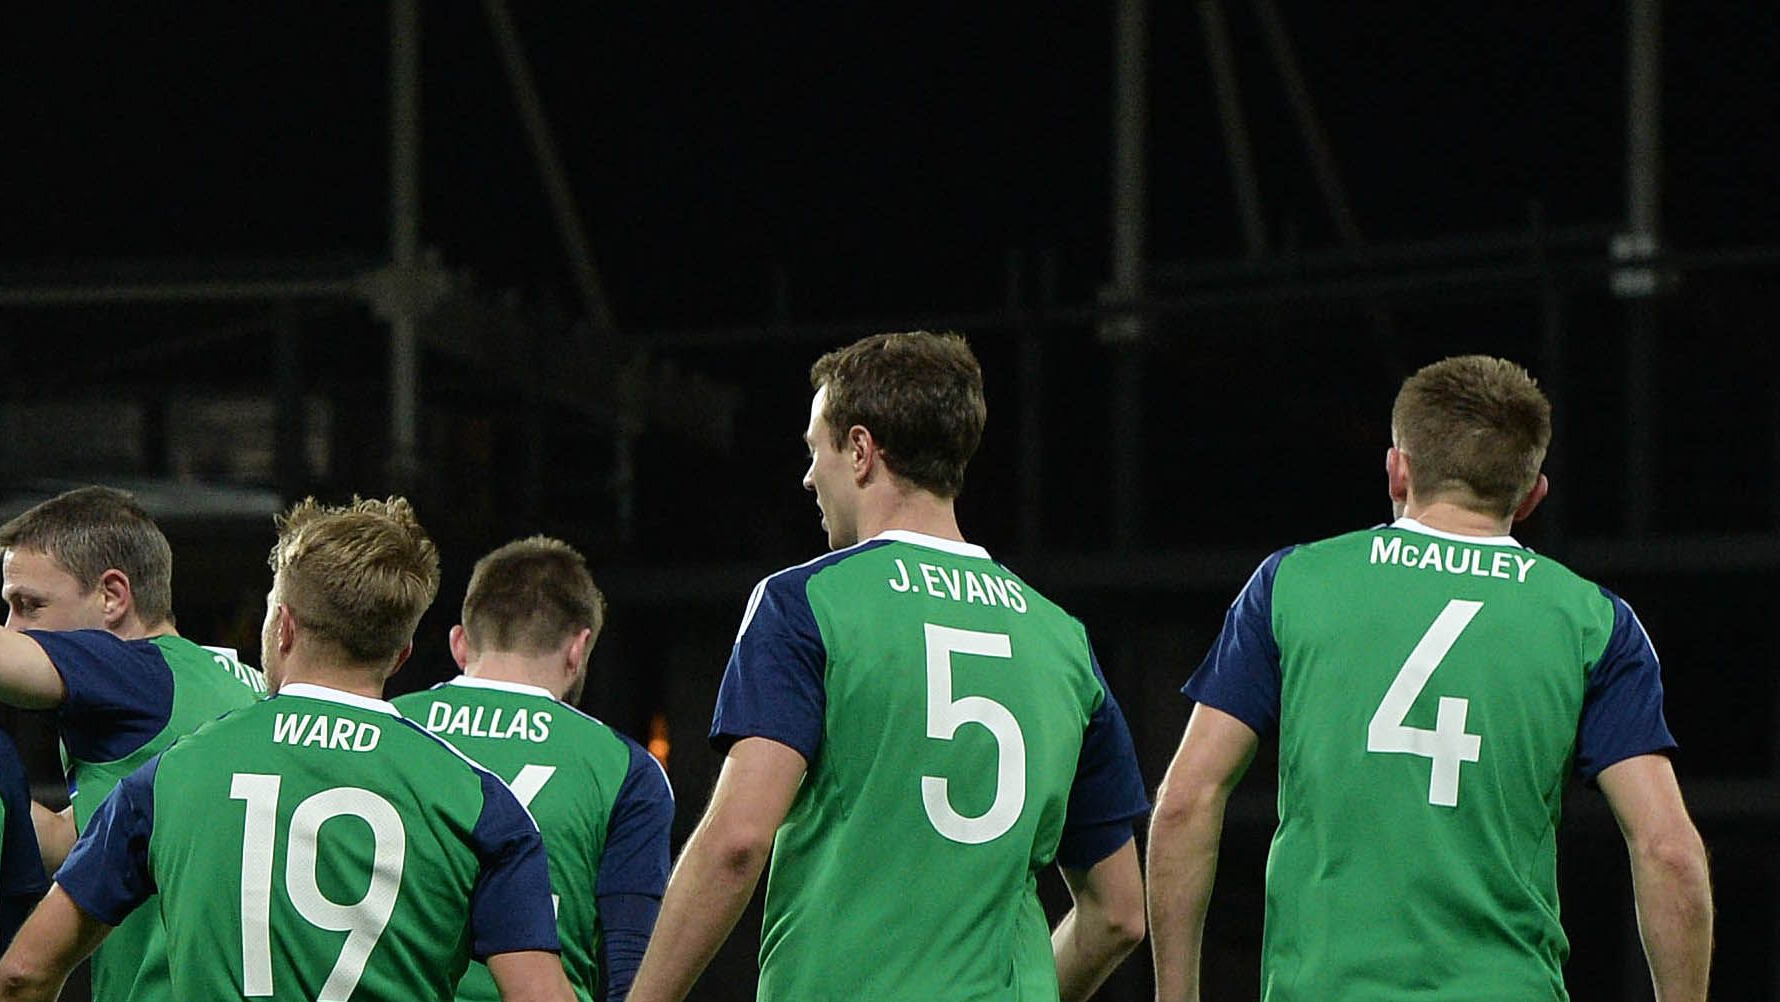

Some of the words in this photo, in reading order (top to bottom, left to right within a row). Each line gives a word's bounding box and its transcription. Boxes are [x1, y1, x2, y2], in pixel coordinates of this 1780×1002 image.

[1369, 535, 1537, 583] McAULEY
[426, 700, 554, 743] DALLAS
[1367, 599, 1484, 807] 4
[272, 712, 381, 752] WARD
[921, 622, 1026, 845] 5
